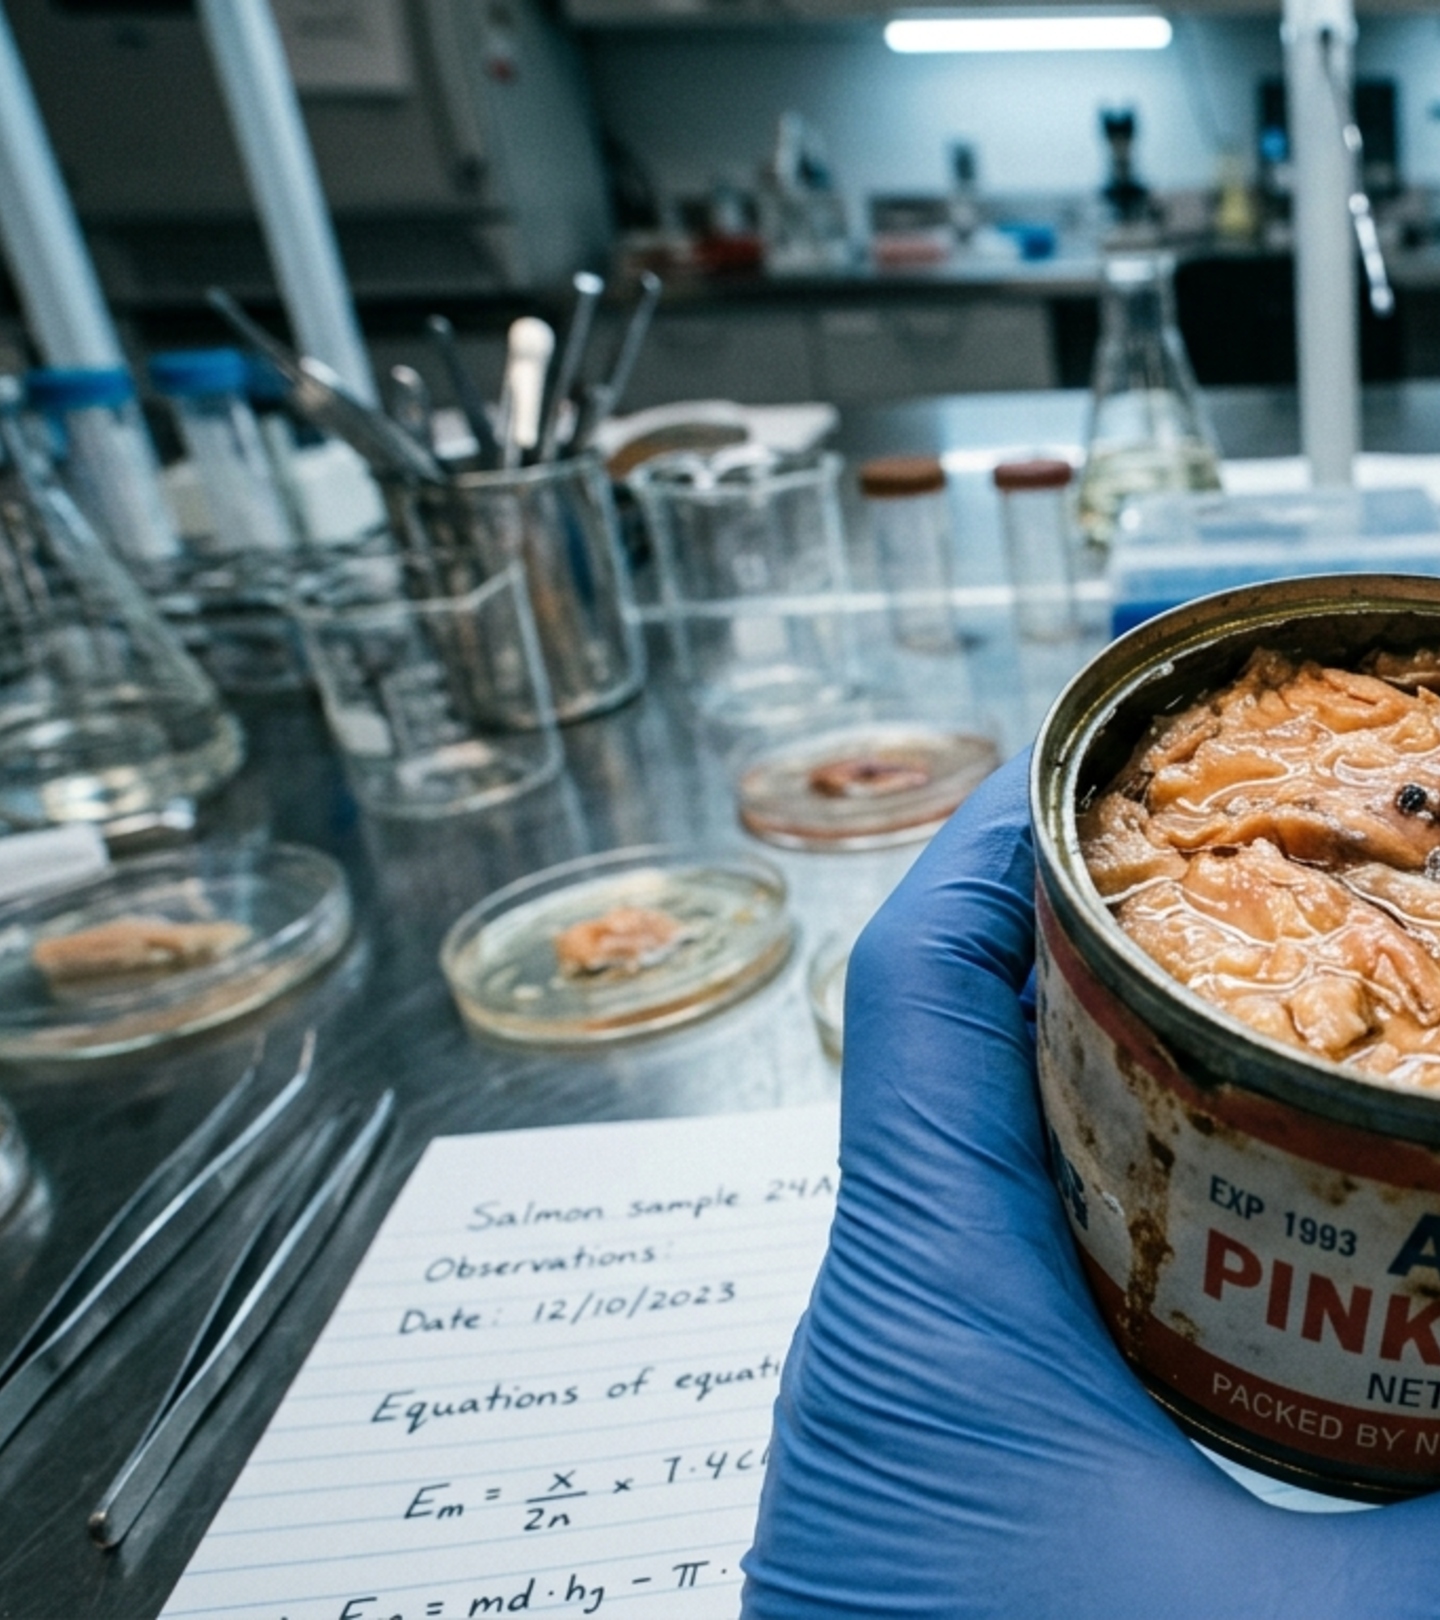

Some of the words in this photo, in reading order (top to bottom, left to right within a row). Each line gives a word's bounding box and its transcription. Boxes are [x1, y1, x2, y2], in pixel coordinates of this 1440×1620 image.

[467, 1199, 604, 1233] Salmon
[627, 1181, 739, 1219] sample
[1209, 1174, 1265, 1220] EXP
[1284, 1211, 1358, 1257] 1993
[424, 1240, 675, 1284] Observations:
[397, 1306, 503, 1336] Date:
[532, 1281, 737, 1326] 12/10/2023
[371, 1383, 579, 1435] Equations
[606, 1366, 657, 1399] of
[1211, 1372, 1344, 1441] PACKED
[1356, 1422, 1406, 1454] BY
